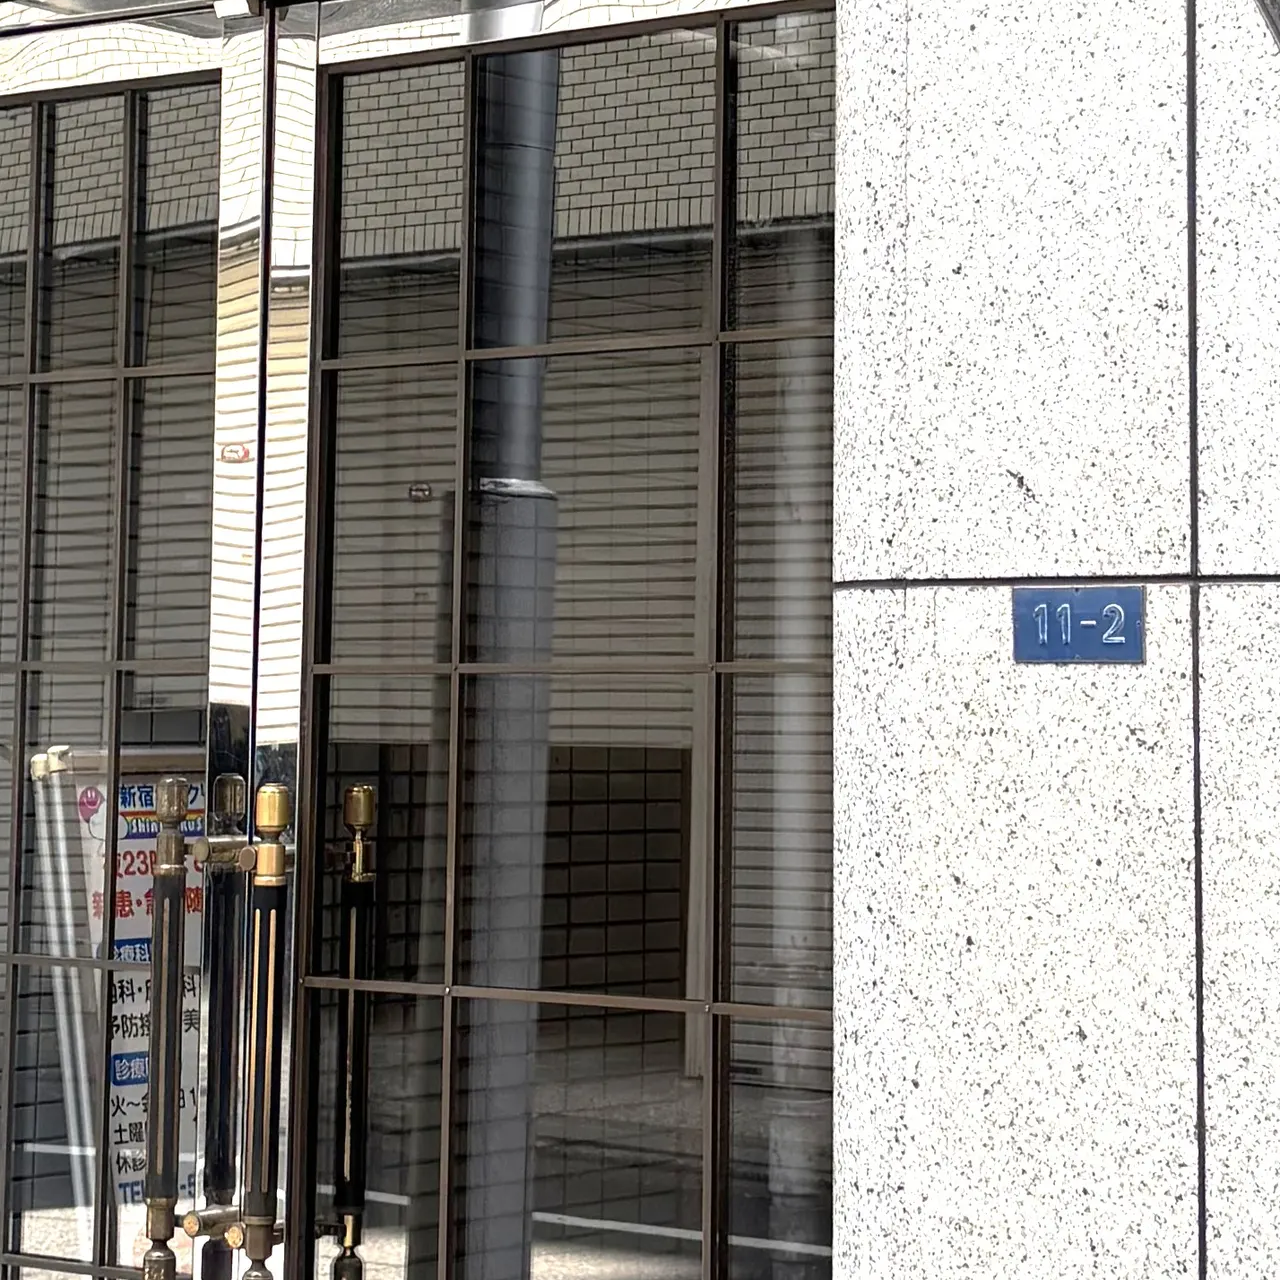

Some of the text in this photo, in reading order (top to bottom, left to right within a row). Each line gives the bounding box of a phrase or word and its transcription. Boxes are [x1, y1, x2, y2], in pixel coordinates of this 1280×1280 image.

[1032, 603, 1126, 644] 11-2
[114, 1056, 149, 1081] 診療
[114, 1121, 148, 1145] 土曜
